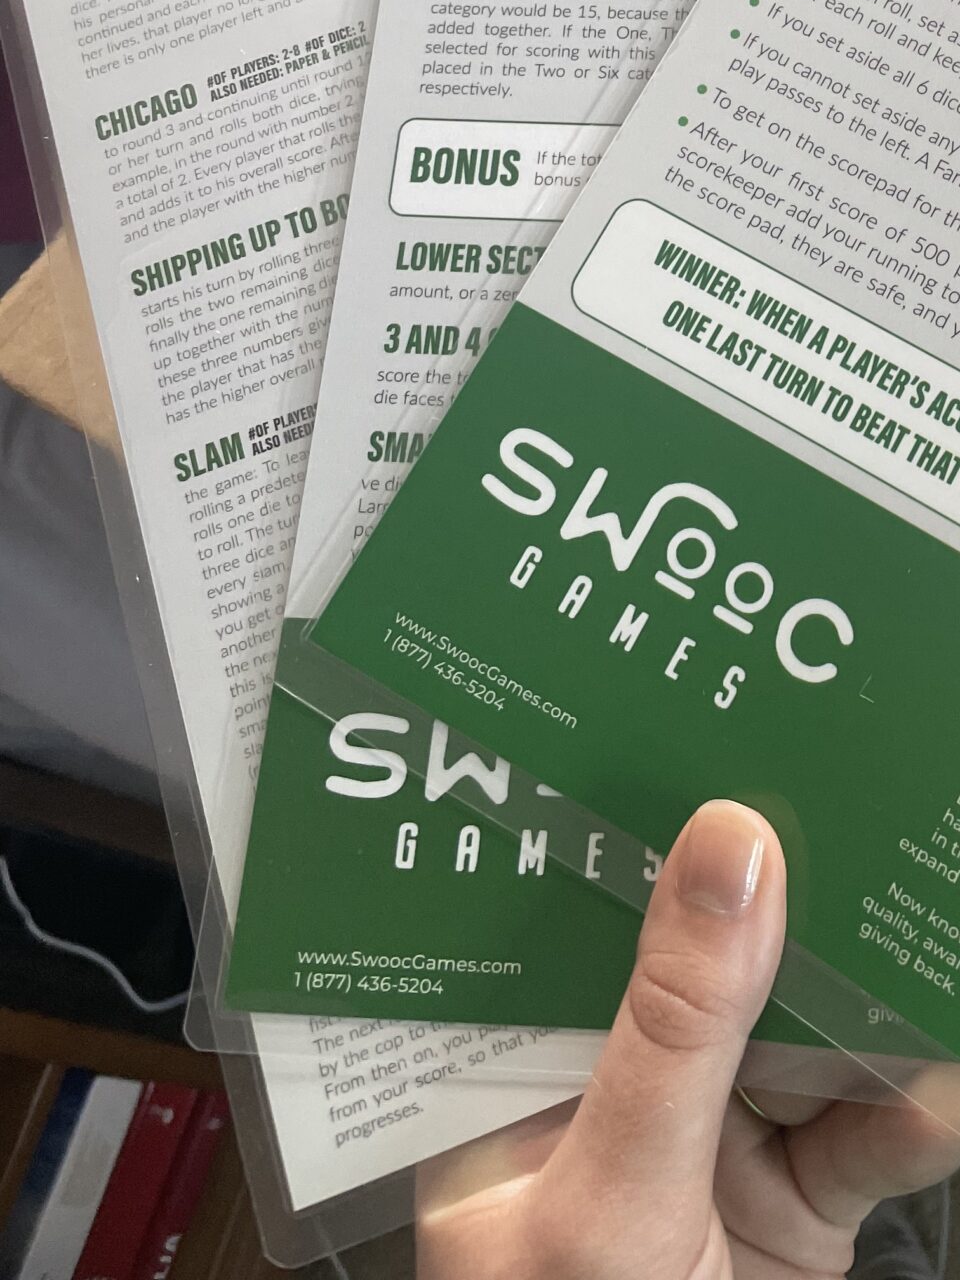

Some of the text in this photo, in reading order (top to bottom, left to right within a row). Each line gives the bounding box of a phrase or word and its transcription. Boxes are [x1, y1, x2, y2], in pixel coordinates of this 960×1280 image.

[94, 83, 198, 141] CHICAGO
[419, 81, 513, 99] respectively.
[409, 146, 521, 187] BONUS
[130, 207, 318, 297] SHIPPING UP TO
[395, 241, 482, 273] LOWER
[383, 323, 481, 357] 3 AND 4
[653, 239, 747, 309] WINNER:
[745, 289, 814, 345] WHEN
[806, 325, 830, 355] A
[825, 334, 931, 409] PLAYER'S
[662, 300, 713, 344] ONE
[705, 323, 768, 373] LAST
[761, 352, 825, 407] TURN
[820, 385, 854, 423] TO
[848, 403, 912, 454] BEAT
[173, 432, 245, 482] SLAM
[509, 545, 746, 710] GAMES
[383, 628, 506, 711] 1 (877) 436-5204
[395, 612, 578, 729] www.SwoocGames.com
[294, 971, 444, 995] 1 (877) 436-5204
[297, 950, 522, 975] www.SwoocGames.com
[335, 1102, 424, 1149] progresses.
